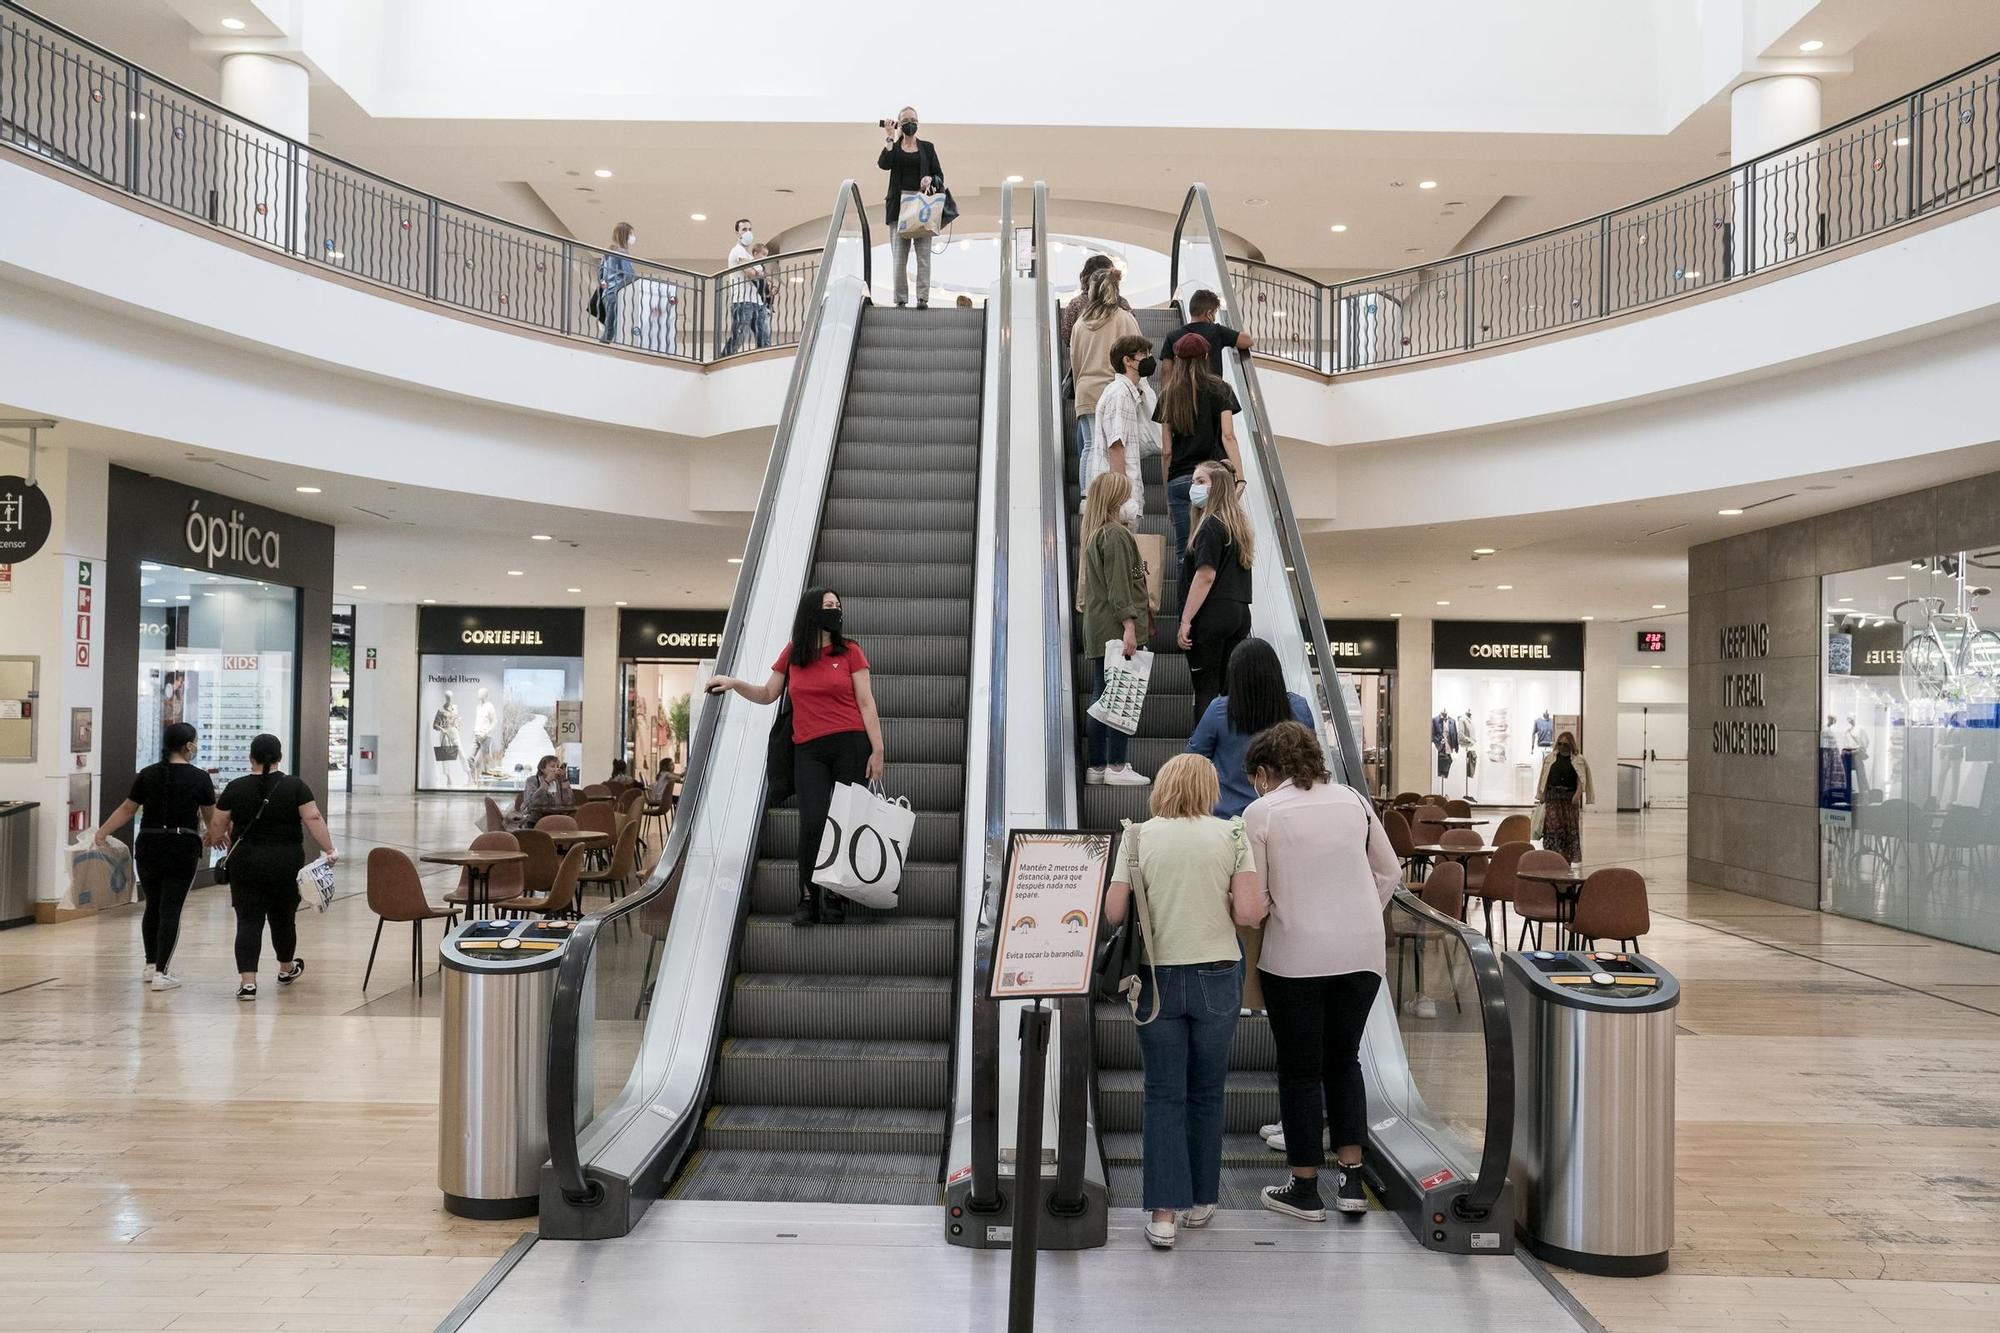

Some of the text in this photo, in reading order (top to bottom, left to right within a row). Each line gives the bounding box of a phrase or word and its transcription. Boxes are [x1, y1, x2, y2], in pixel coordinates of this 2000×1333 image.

[186, 500, 280, 568] óptica
[461, 630, 543, 645] CORTEFIEL
[1720, 622, 1769, 659] KEEPING
[1469, 644, 1551, 659] CORTEFIEL
[223, 656, 257, 669] KIDS
[428, 674, 480, 683] Pedro del Hierro
[1723, 673, 1766, 707] IT REAL
[561, 722, 576, 734] 50
[1713, 720, 1778, 756] SINCE 1990
[1019, 863, 1047, 872] Mantén
[1054, 864, 1079, 872] metros
[1018, 873, 1083, 882] distancia, para que
[1016, 882, 1045, 891] después
[1015, 892, 1040, 900] separe.
[1006, 951, 1024, 960] Evita
[1043, 950, 1050, 958] la
